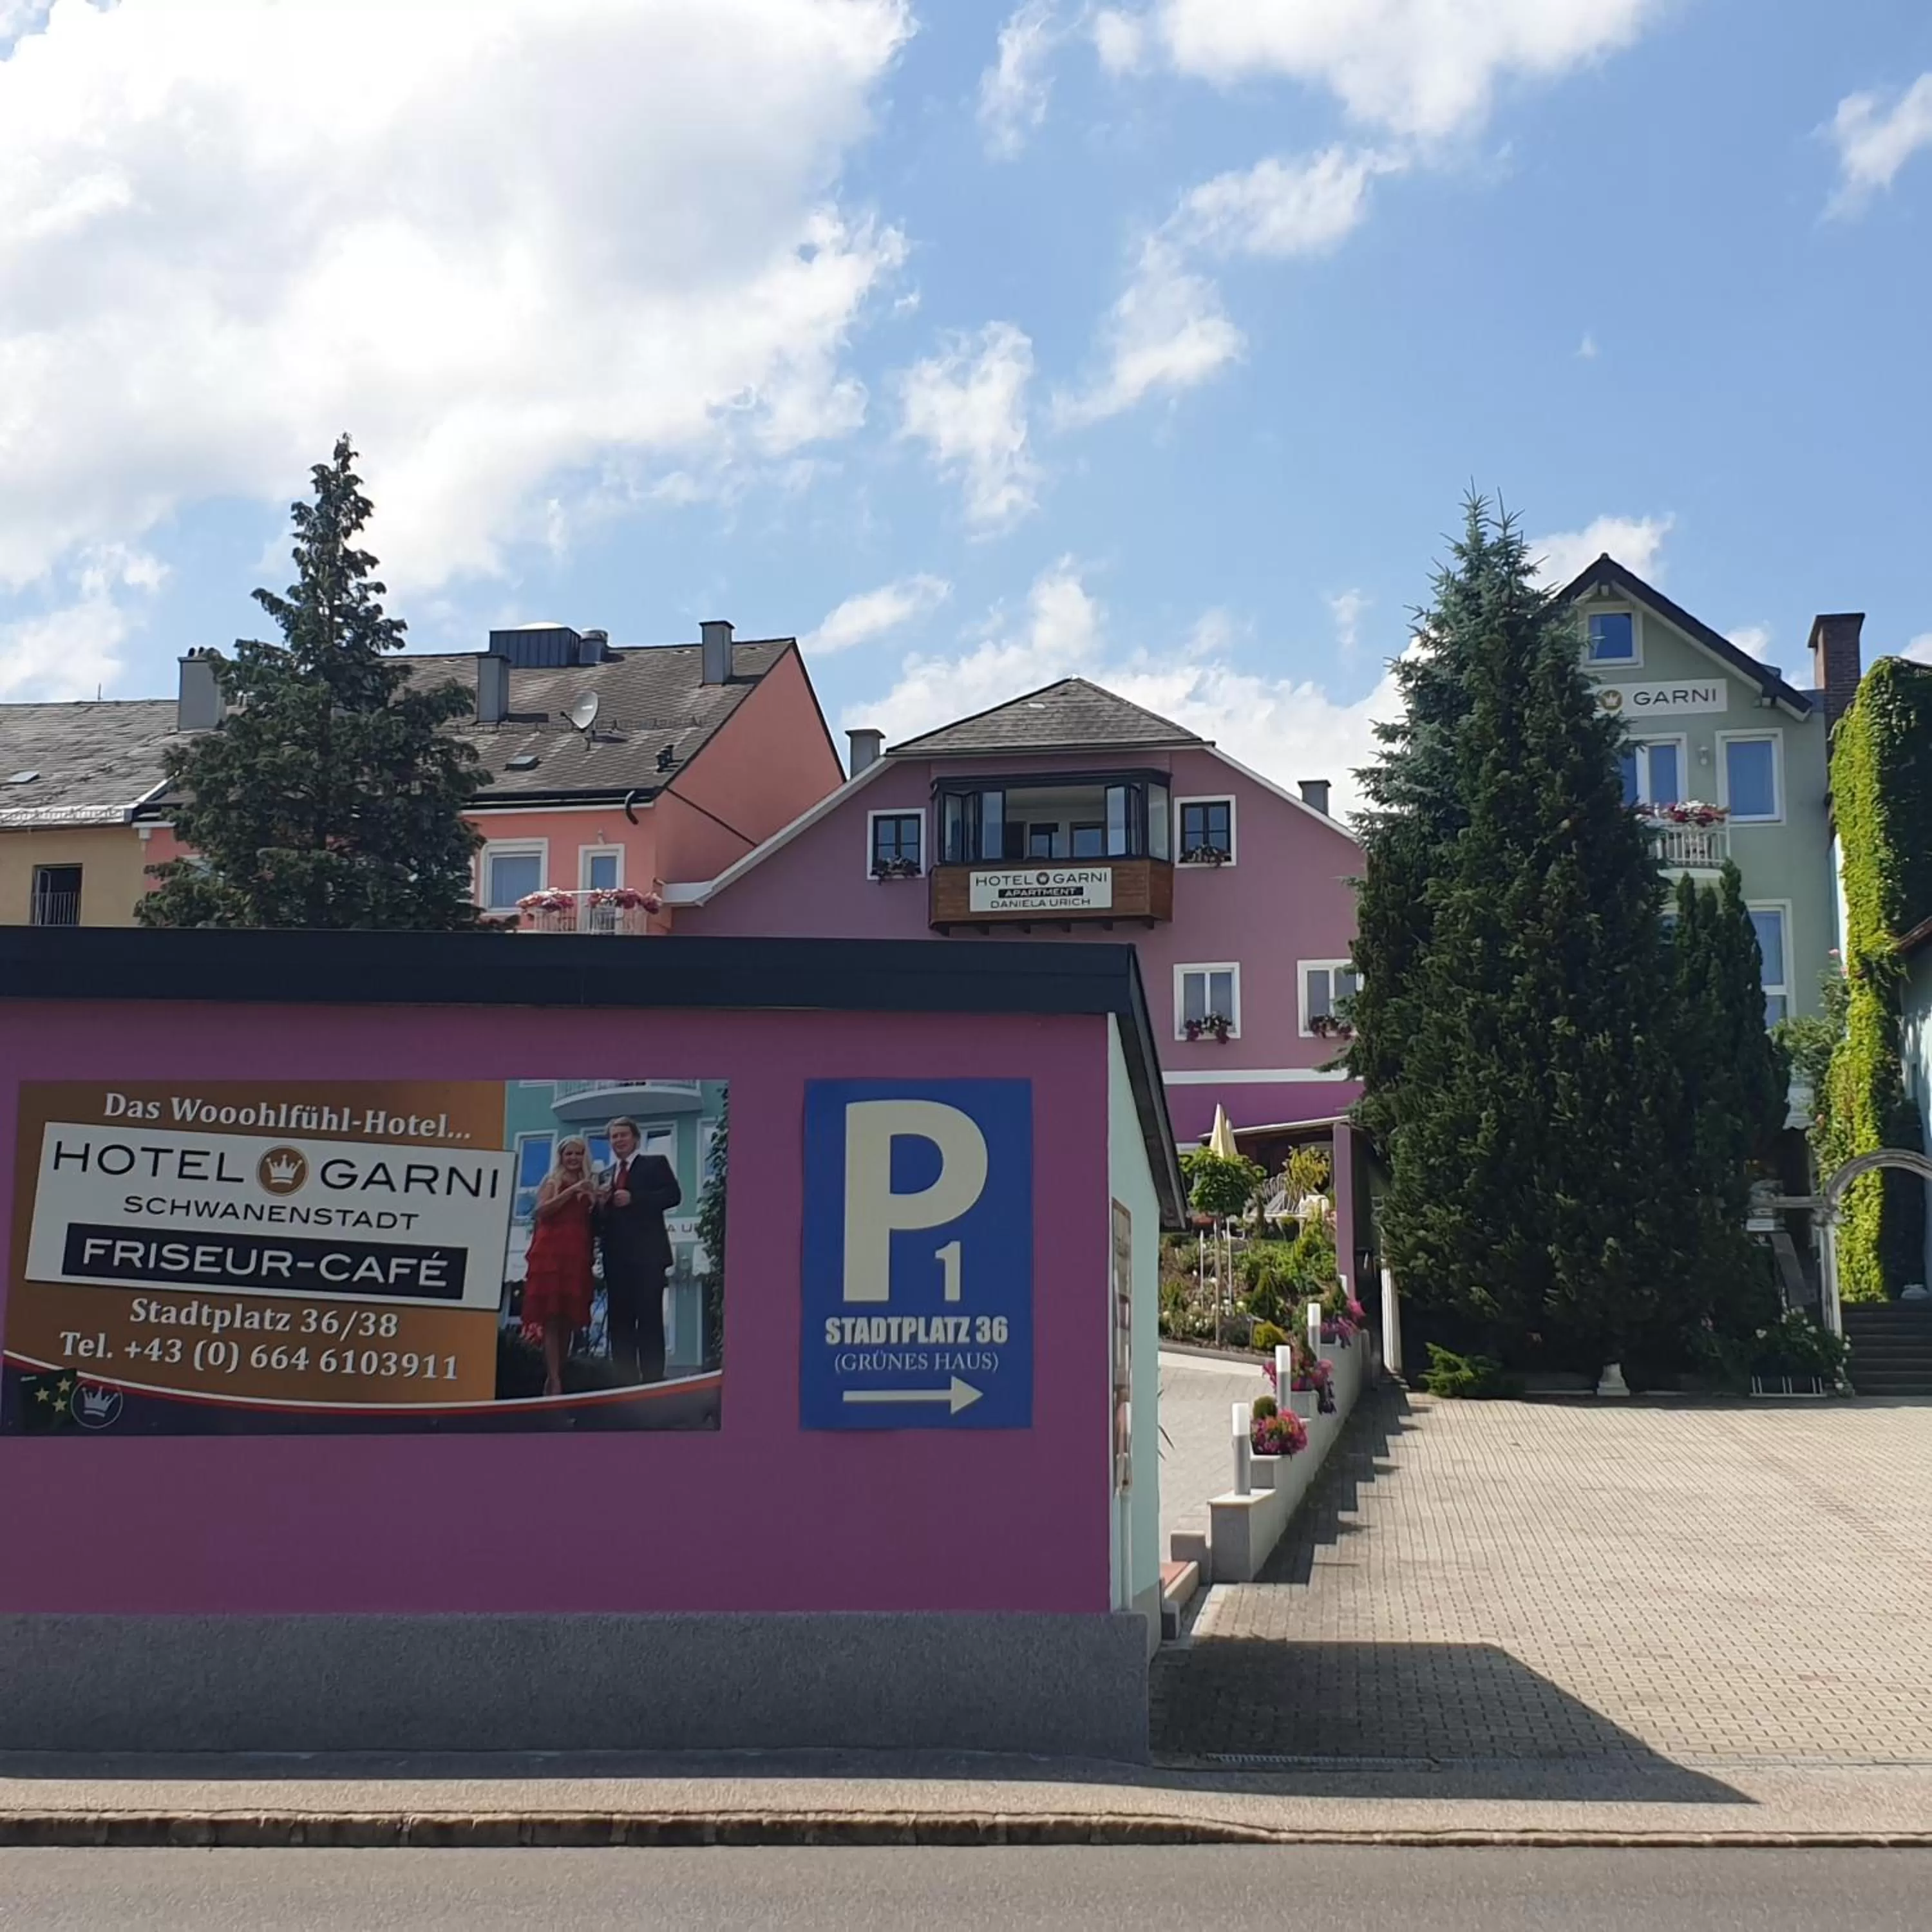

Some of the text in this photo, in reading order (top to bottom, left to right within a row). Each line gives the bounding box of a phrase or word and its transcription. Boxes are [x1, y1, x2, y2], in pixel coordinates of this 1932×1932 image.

[1633, 688, 1717, 706] GARNI
[975, 871, 1108, 887] HOTEL GARNI
[1004, 887, 1077, 897] APARTMENT
[990, 898, 1091, 909] DANIELA URICH
[103, 1093, 160, 1119] Das
[53, 1141, 499, 1198] HOTEL GARNI
[123, 1195, 421, 1231] SCHWANENSTADT
[842, 1099, 988, 1302] P 1
[82, 1238, 449, 1287] FRISEUR-CAFÉ
[129, 1298, 399, 1342] Stadtplatz 36/38
[825, 1316, 1009, 1345] STADTPLATZ 36
[59, 1332, 459, 1380] Tel. +43 (0) 664 6103911
[834, 1350, 1000, 1373] (GRÜNES HAUS)
